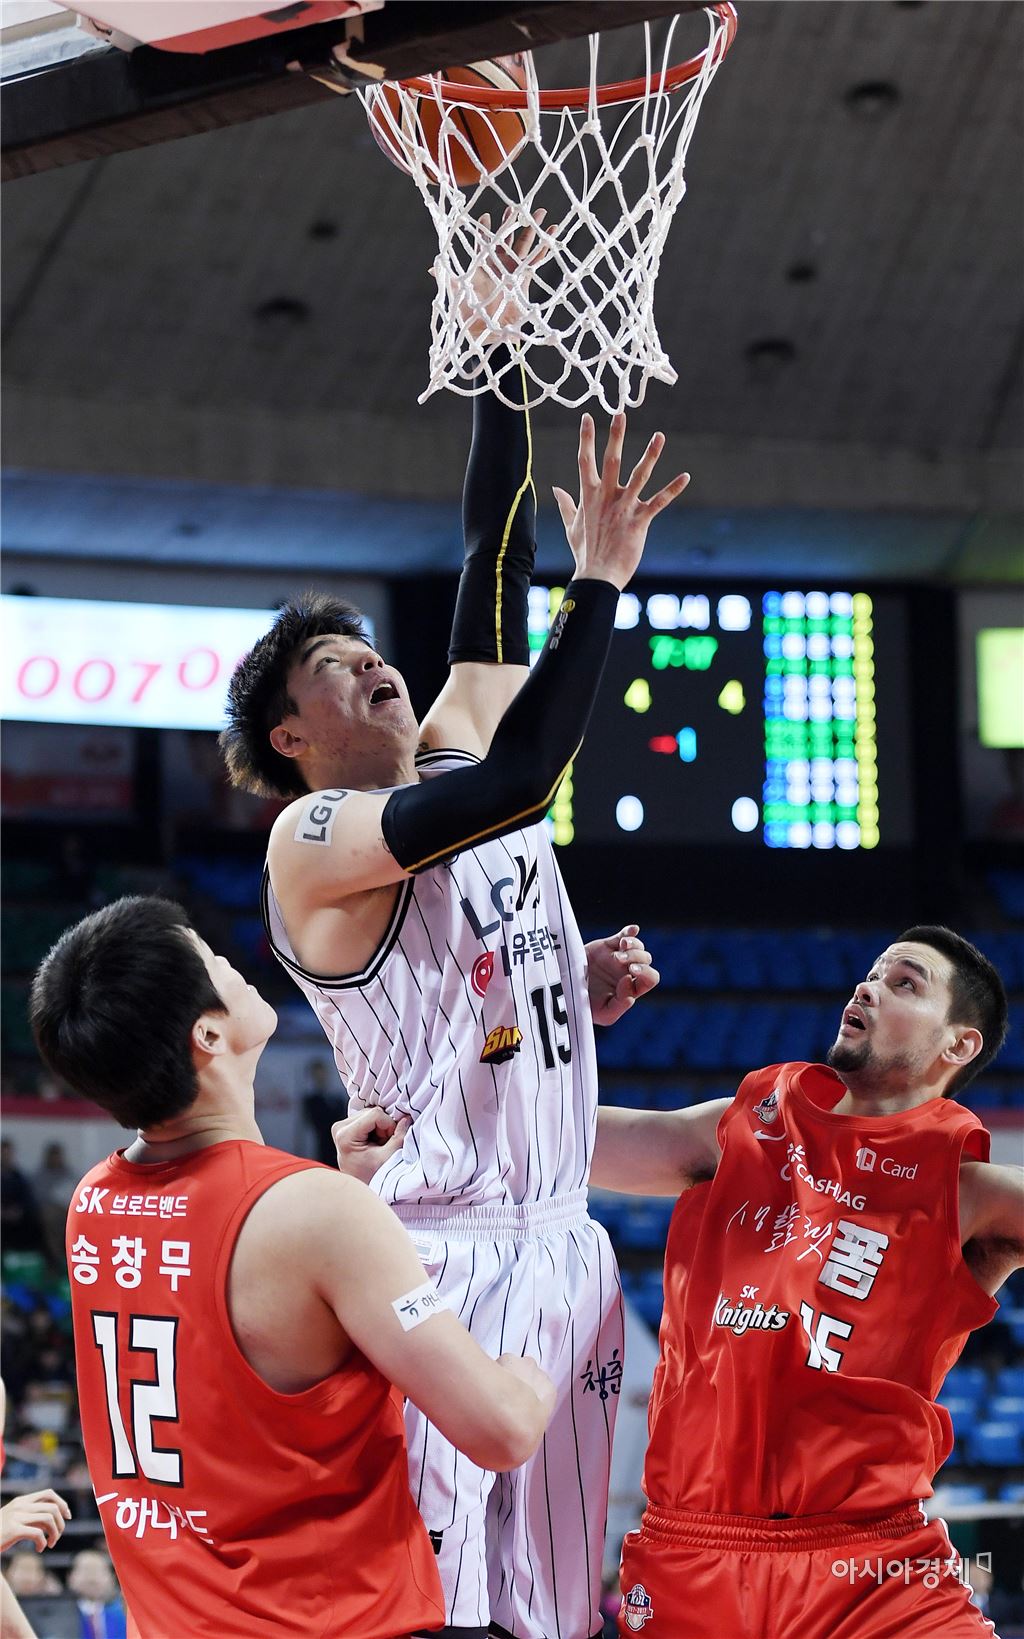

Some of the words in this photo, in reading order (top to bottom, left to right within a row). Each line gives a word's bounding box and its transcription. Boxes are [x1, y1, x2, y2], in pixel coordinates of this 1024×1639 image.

[797, 1163, 867, 1212] CASHAG
[880, 1158, 919, 1180] Card
[76, 1186, 110, 1214] SK
[110, 1194, 189, 1219] 브로드밴드
[740, 1285, 759, 1299] SK
[713, 1297, 790, 1336] Knights
[800, 1301, 854, 1373] 15
[91, 1310, 184, 1489] 12
